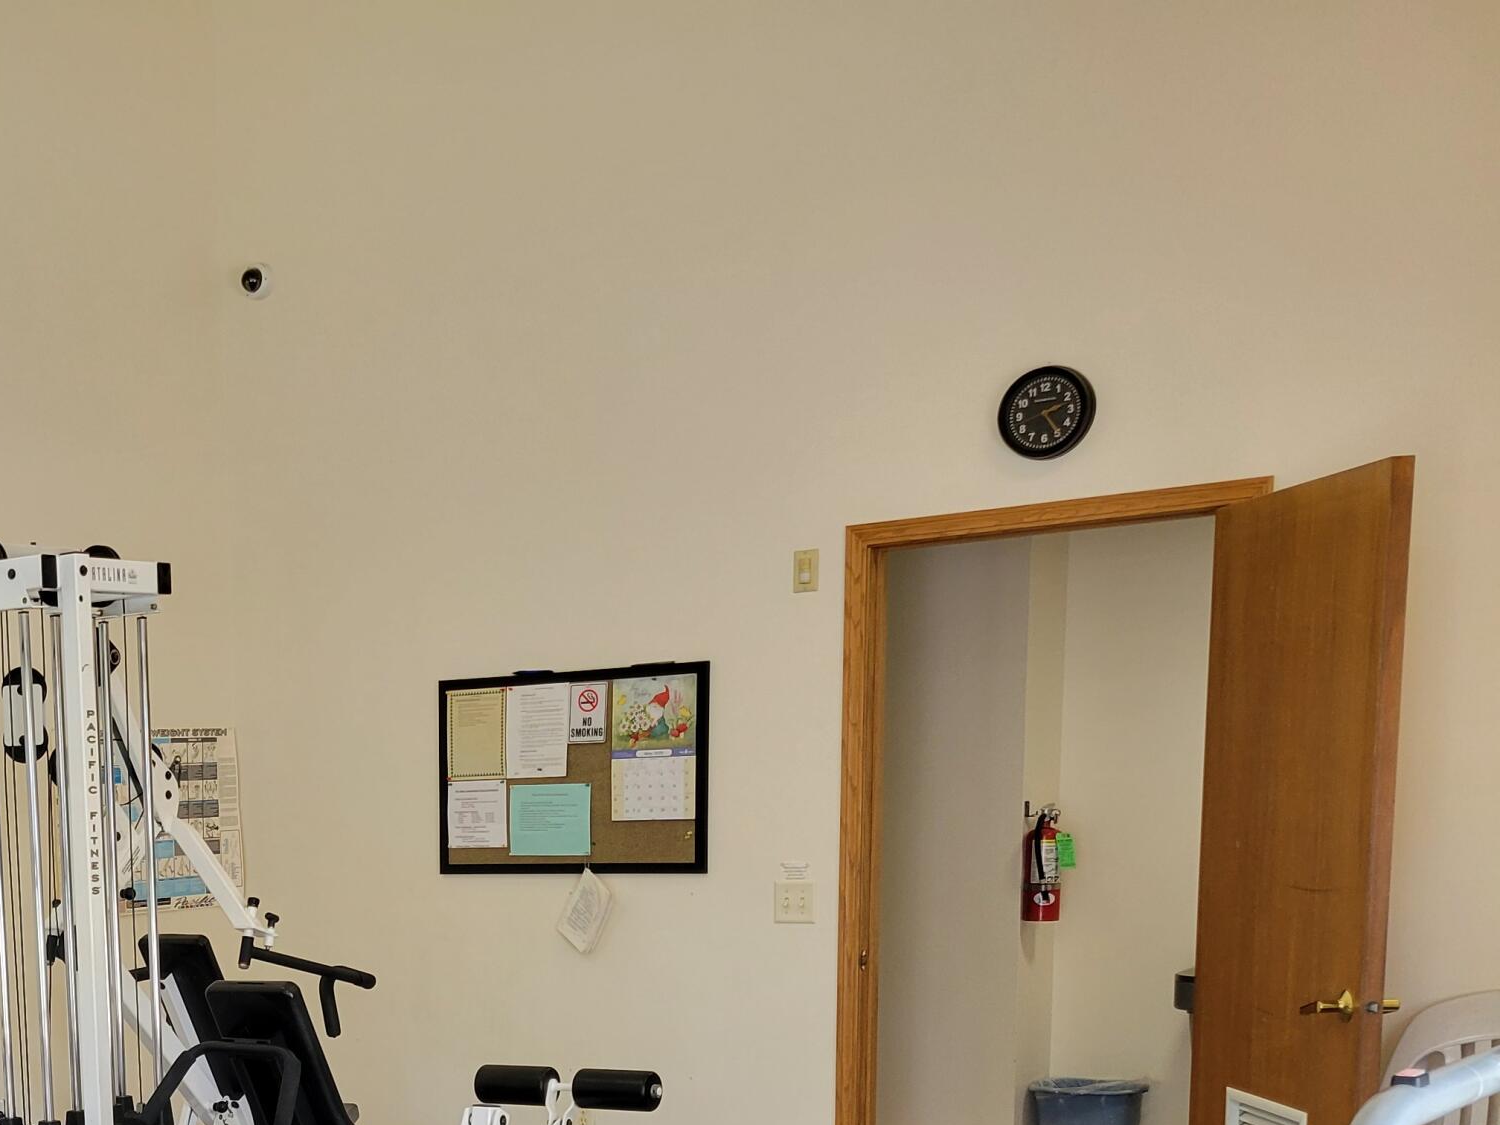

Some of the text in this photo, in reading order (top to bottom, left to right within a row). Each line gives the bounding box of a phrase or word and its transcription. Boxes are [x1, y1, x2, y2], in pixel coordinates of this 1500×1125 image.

[1040, 382, 1050, 392] 12
[1056, 384, 1061, 392] 1
[1028, 388, 1037, 398] 11
[1064, 392, 1071, 401] 2
[1018, 400, 1028, 409] 10
[1067, 404, 1074, 413] 3
[1016, 412, 1023, 422] 9
[1063, 418, 1071, 426] 4
[1019, 424, 1026, 434] 8
[1028, 432, 1035, 442] 7
[1040, 434, 1048, 443] 6
[91, 566, 126, 582] ATALINA
[582, 716, 592, 726] NO
[192, 728, 228, 736] SYSTEM
[570, 727, 603, 738] SMOKING
[86, 709, 100, 896] PACIFIC FITNESS
